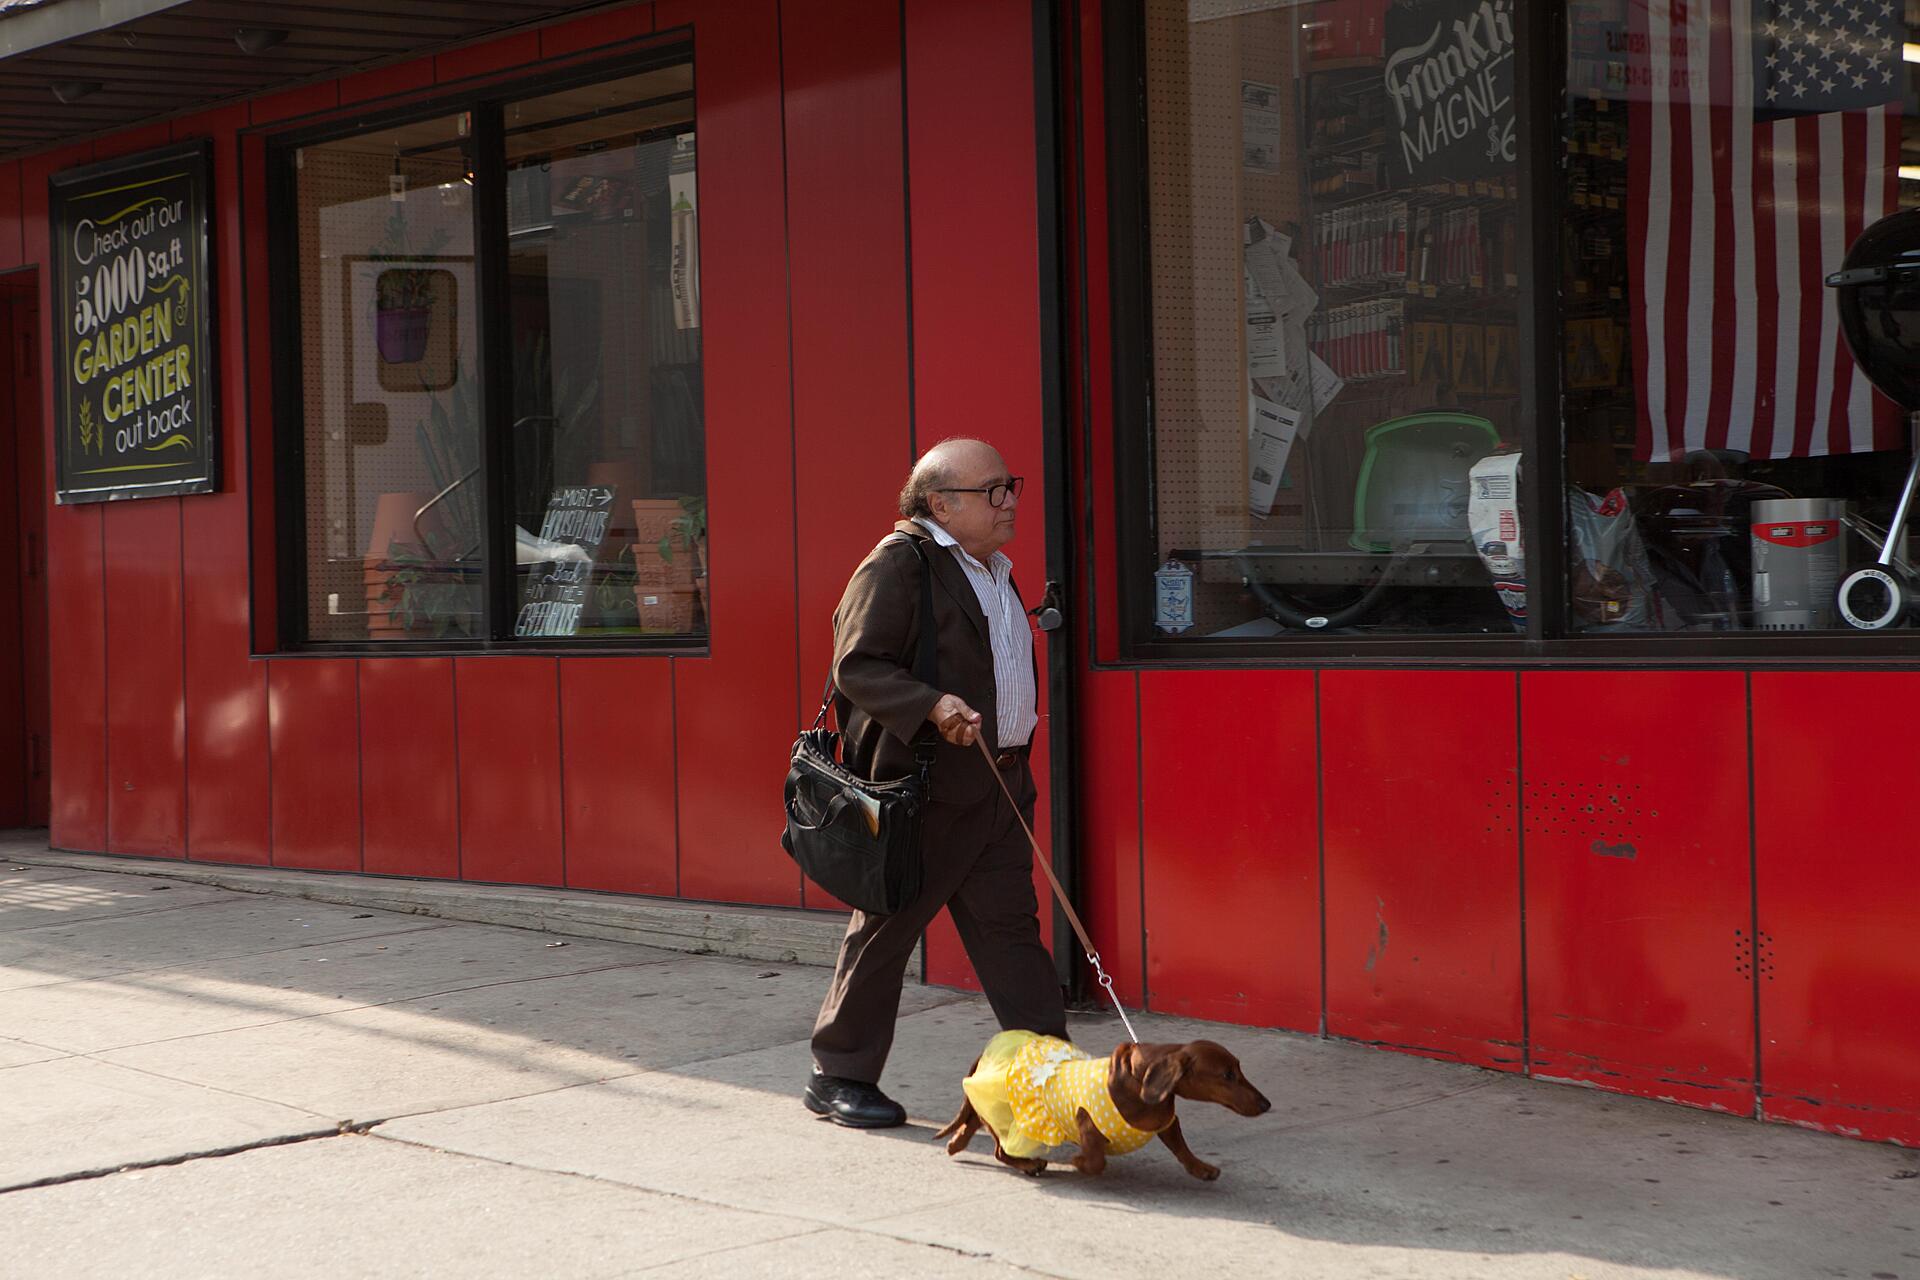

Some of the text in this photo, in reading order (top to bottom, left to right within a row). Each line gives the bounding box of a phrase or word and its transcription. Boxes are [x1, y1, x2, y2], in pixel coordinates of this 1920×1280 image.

[1400, 49, 1514, 175] MAGNE
[74, 197, 184, 265] Check out our
[74, 245, 146, 336] 5,000
[73, 297, 172, 385] GARDEN
[102, 348, 192, 424] CENTER
[115, 395, 192, 454] out back
[560, 488, 597, 508] MORE
[531, 584, 579, 602] IN THE
